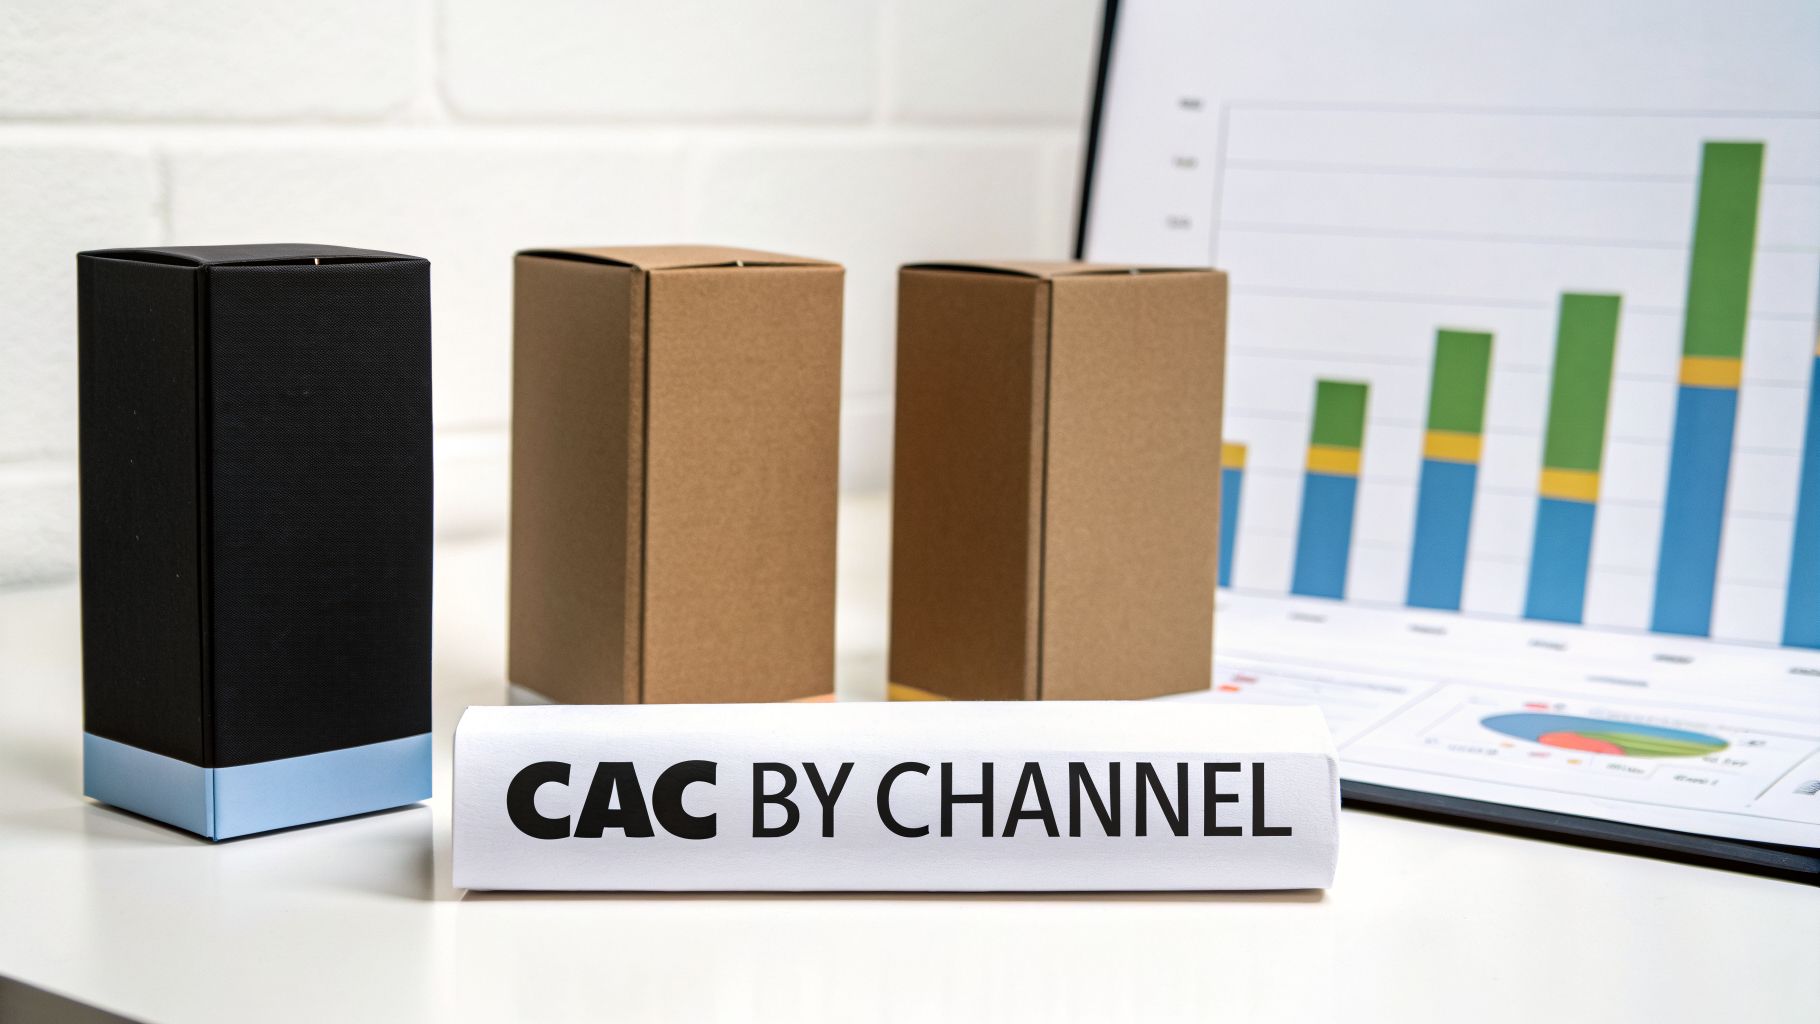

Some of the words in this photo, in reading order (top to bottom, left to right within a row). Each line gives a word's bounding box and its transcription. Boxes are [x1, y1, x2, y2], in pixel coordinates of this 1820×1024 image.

[506, 760, 718, 840] CAC
[752, 762, 855, 838] BY
[876, 761, 1293, 838] CHANNEL
